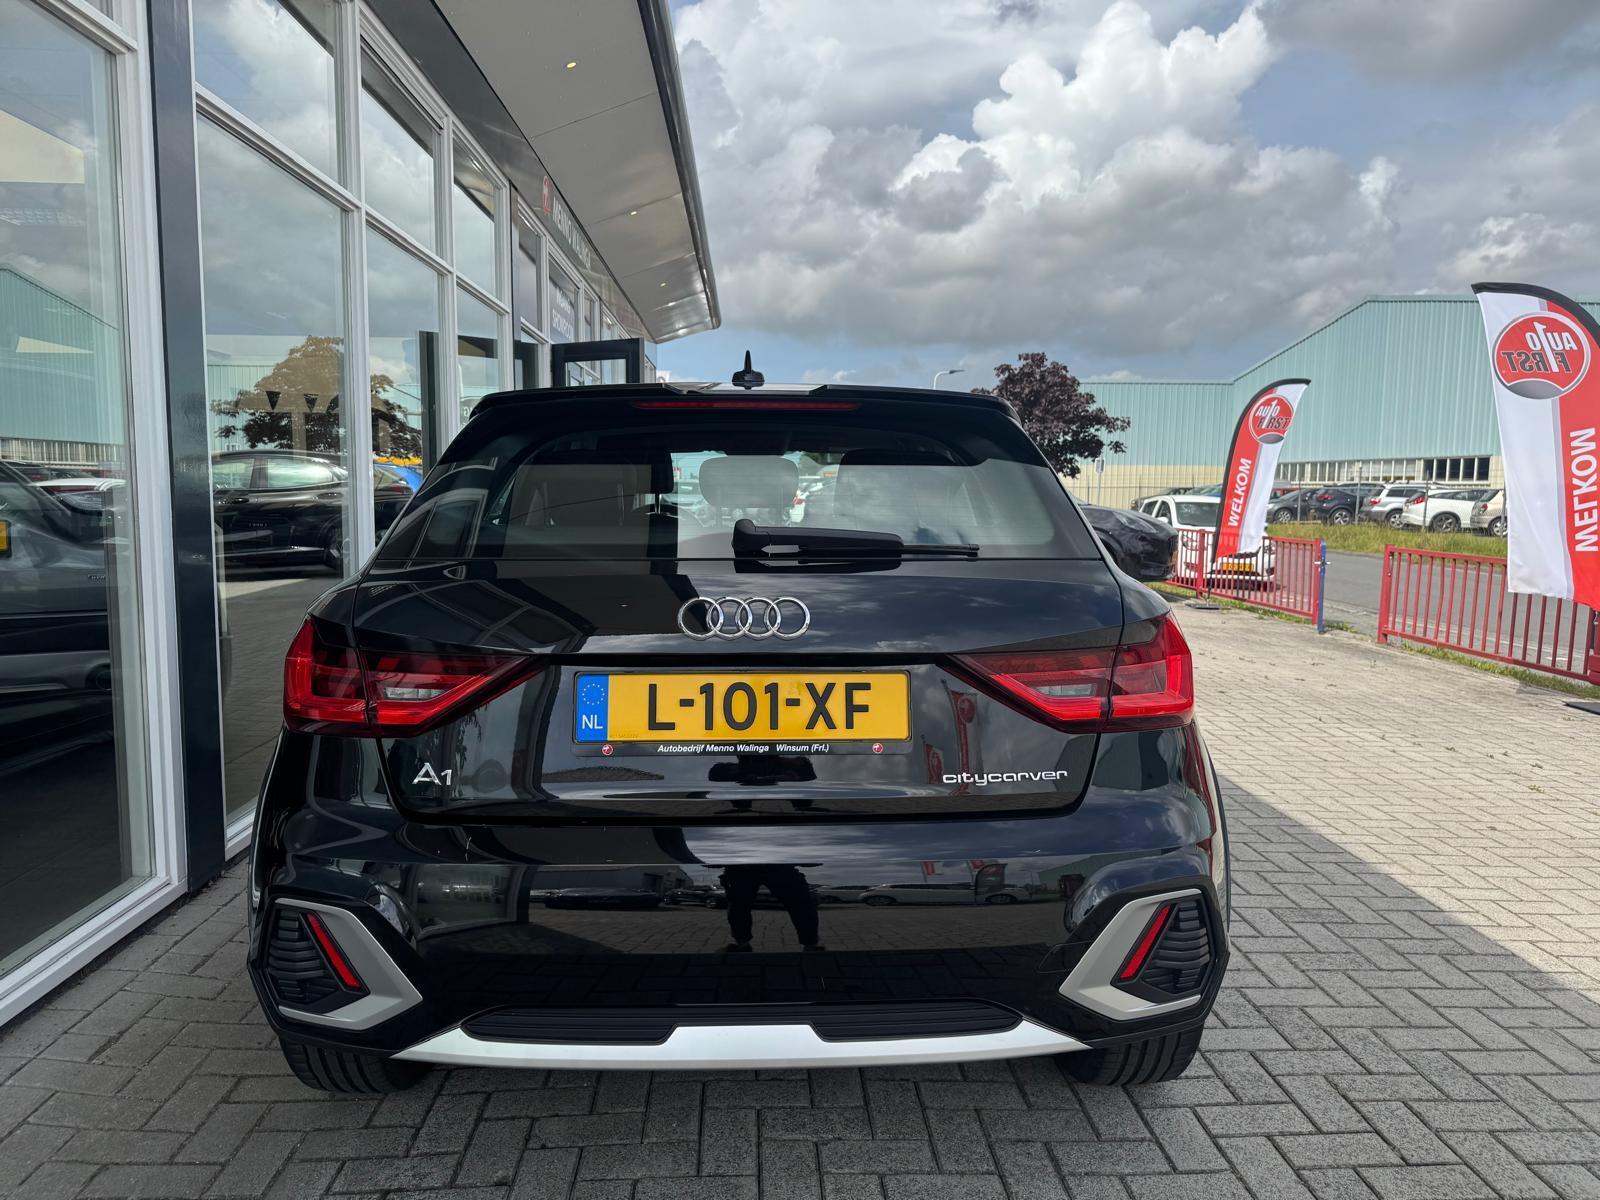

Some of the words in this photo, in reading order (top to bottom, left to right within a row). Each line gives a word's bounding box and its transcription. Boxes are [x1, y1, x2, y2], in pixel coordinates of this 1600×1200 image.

[1227, 457, 1252, 527] WELKOM
[647, 681, 872, 731] L-101-XF
[582, 714, 603, 730] NL
[657, 743, 704, 753] Autobedrijf
[705, 743, 735, 753] Menno
[736, 743, 769, 754] Walinga
[775, 743, 809, 753] Winsum
[810, 743, 829, 754] (Frl.)
[412, 761, 453, 786] A1
[942, 770, 1068, 786] citycarver
